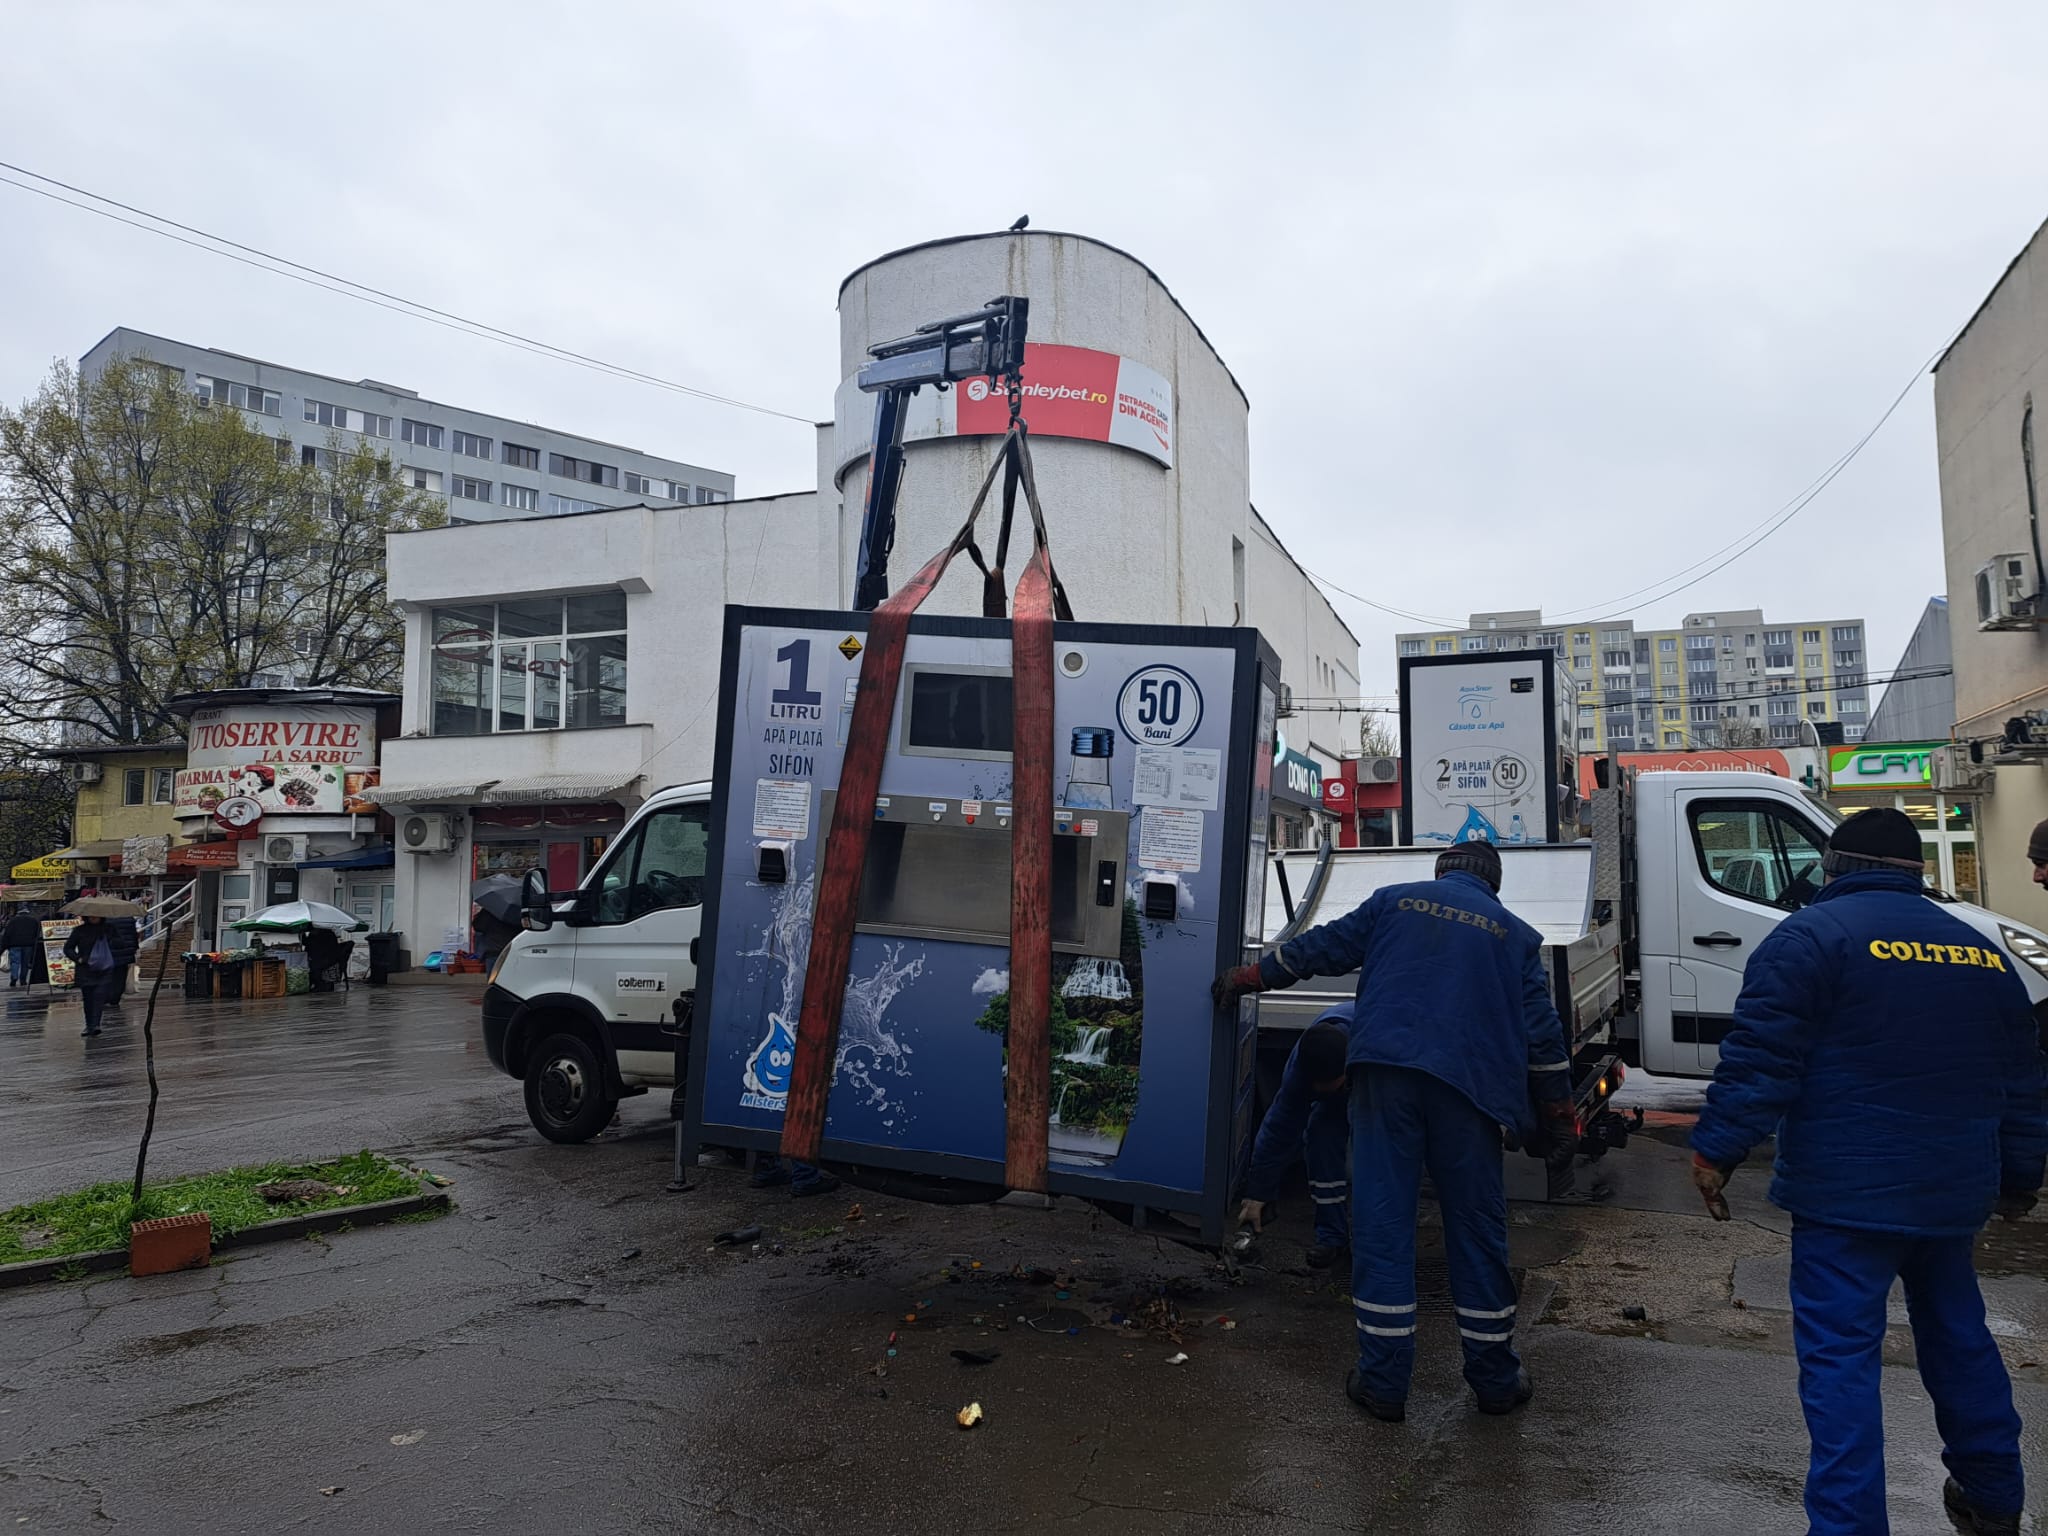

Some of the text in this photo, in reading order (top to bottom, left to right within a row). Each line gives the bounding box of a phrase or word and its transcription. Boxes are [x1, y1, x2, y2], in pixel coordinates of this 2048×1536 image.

[990, 383, 1108, 404] Stnleybet.ro
[1119, 402, 1137, 417] DIN
[772, 639, 822, 706] 1
[770, 704, 822, 720] LITRU
[1138, 679, 1182, 726] 50
[764, 727, 823, 747] APĂ PLATĂ
[1143, 726, 1172, 739] Bani
[769, 753, 814, 776] SIFON
[1436, 758, 1451, 782] 2
[1502, 763, 1518, 780] 50
[1288, 760, 1309, 795] DONA
[1458, 776, 1487, 789] SIFON
[1398, 897, 1508, 939] COLTERM
[617, 976, 656, 988] colterm
